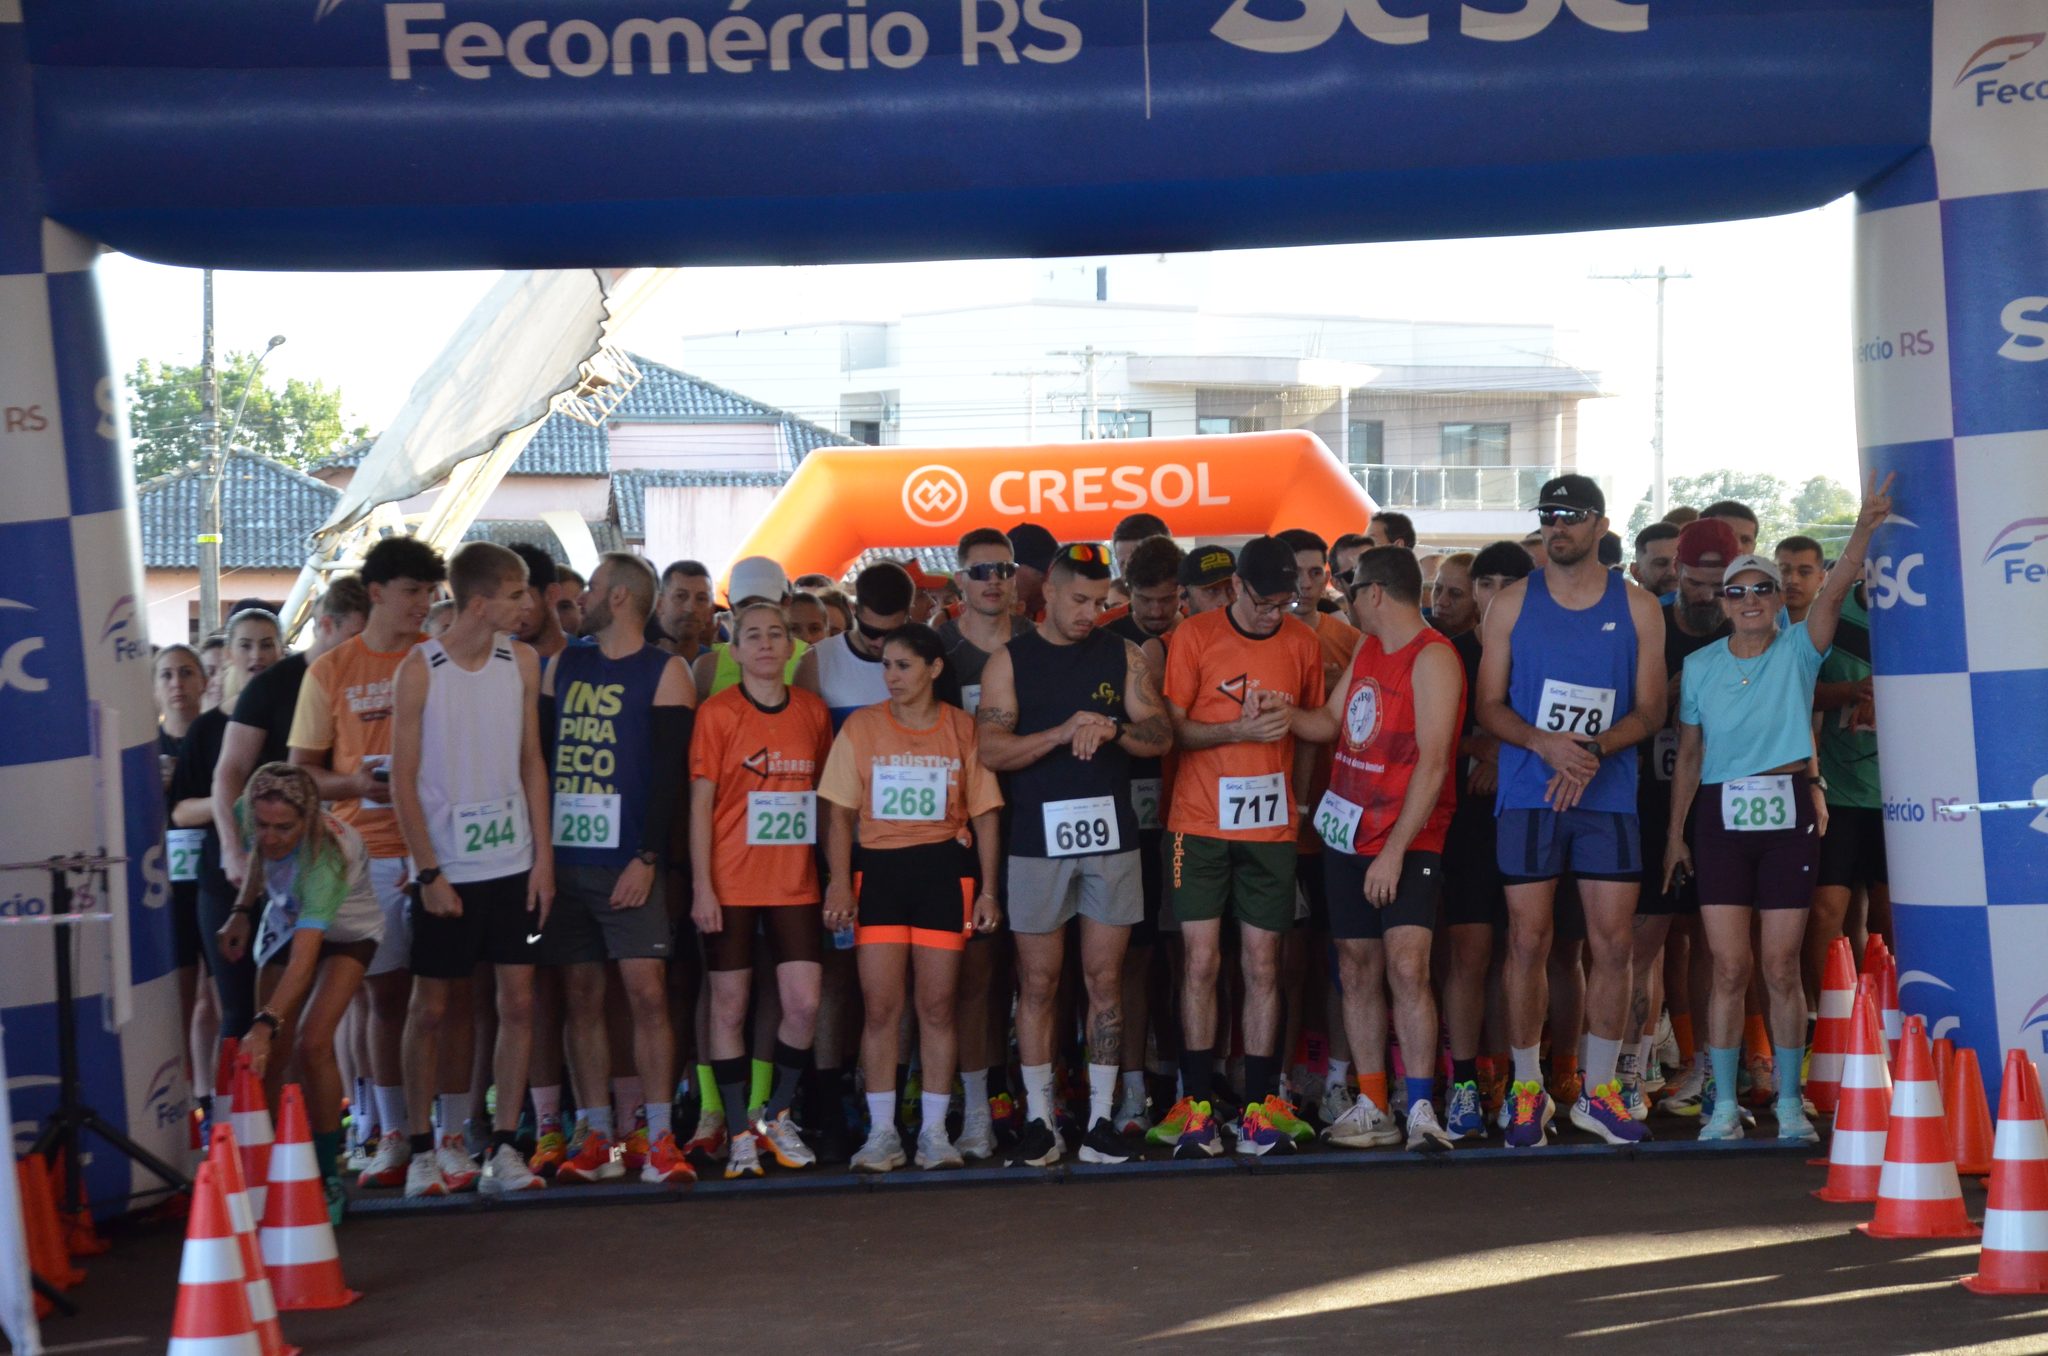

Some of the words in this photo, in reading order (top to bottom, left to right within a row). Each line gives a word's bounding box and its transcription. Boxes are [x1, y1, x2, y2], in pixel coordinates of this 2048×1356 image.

[386, 0, 928, 80] Fecomércio
[962, 0, 1082, 65] RS
[1900, 329, 1935, 357] RS
[5, 404, 49, 433] RS
[989, 462, 1231, 516] CRESOL
[563, 680, 625, 717] INS
[559, 716, 617, 744] PIRA
[1547, 702, 1603, 737] 578
[555, 745, 615, 777] ECO
[882, 786, 937, 816] 268
[1229, 793, 1279, 825] 717
[1731, 796, 1786, 827] 283
[464, 815, 515, 852] 244
[560, 813, 610, 843] 289
[756, 811, 807, 840] 226
[1056, 818, 1110, 850] 689
[1320, 811, 1350, 849] 334
[1174, 831, 1185, 889] adidas
